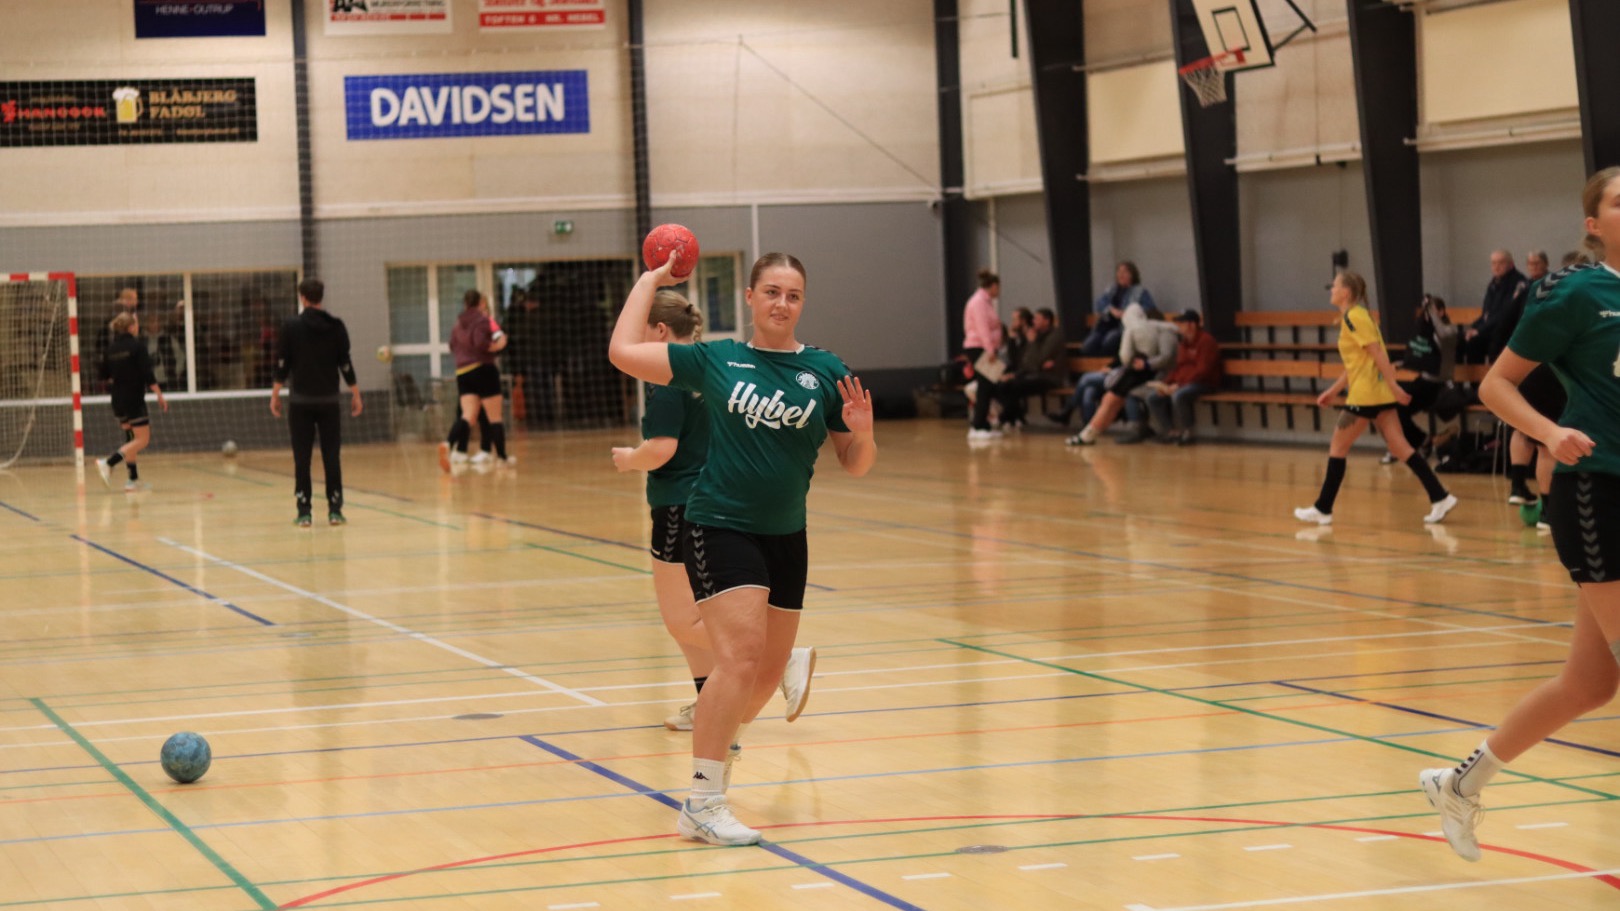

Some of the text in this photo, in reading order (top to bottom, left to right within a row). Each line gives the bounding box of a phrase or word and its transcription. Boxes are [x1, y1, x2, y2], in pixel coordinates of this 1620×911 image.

[149, 86, 237, 105] BLÅBJERG
[370, 83, 565, 126] DAVIDSEN
[727, 381, 817, 430] Hybel
